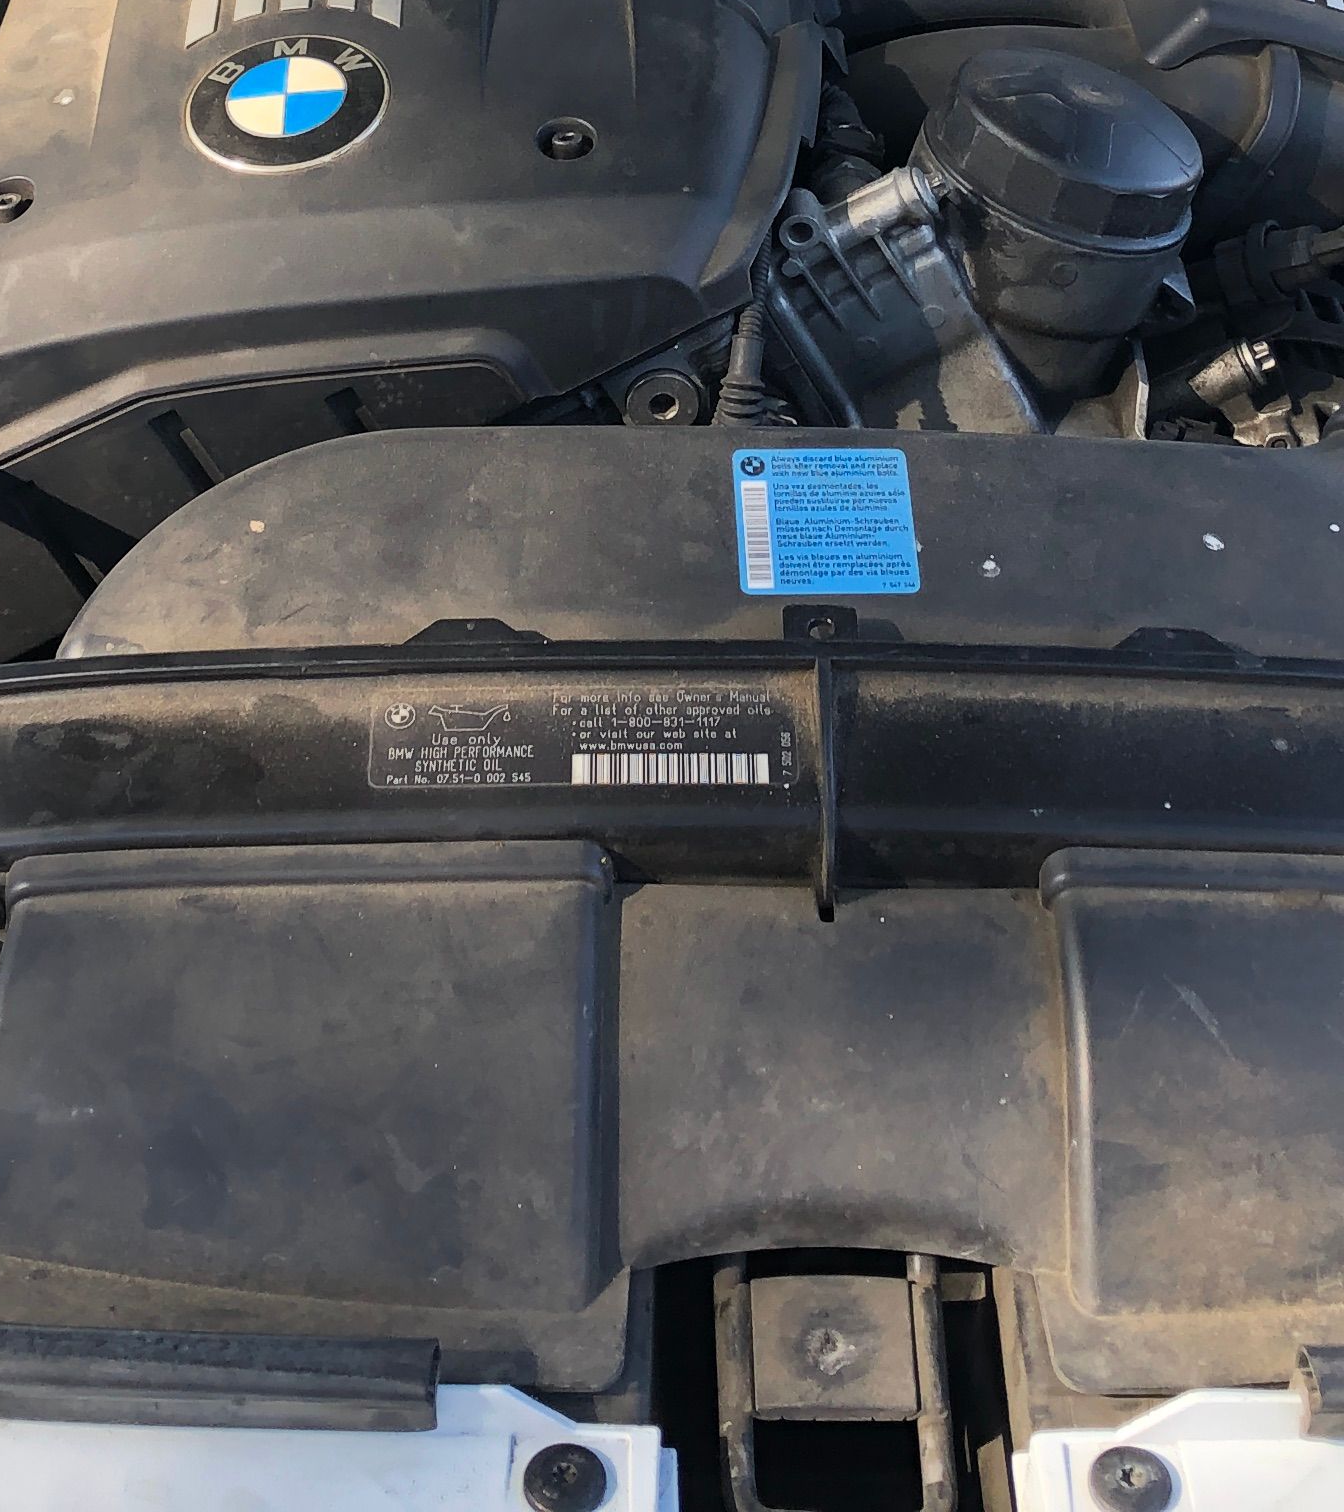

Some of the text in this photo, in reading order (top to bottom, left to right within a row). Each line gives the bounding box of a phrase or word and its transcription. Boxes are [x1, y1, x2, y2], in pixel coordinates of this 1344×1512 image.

[207, 38, 374, 85] BMW
[676, 689, 722, 703] Owners
[553, 703, 573, 716] For
[580, 707, 588, 716] a
[595, 703, 617, 716] list
[625, 704, 638, 715] of
[646, 703, 677, 715] other
[686, 704, 740, 716] approved
[579, 717, 603, 728] call
[579, 728, 737, 739] or visit our web site at
[432, 733, 501, 749] Use only
[579, 740, 683, 750] www.bmwusa.com
[388, 745, 534, 760] BMW HIGH PERFORMANCE
[415, 759, 502, 773] SYNTHETIC OIL
[386, 774, 408, 784] Part
[487, 773, 505, 783] 002
